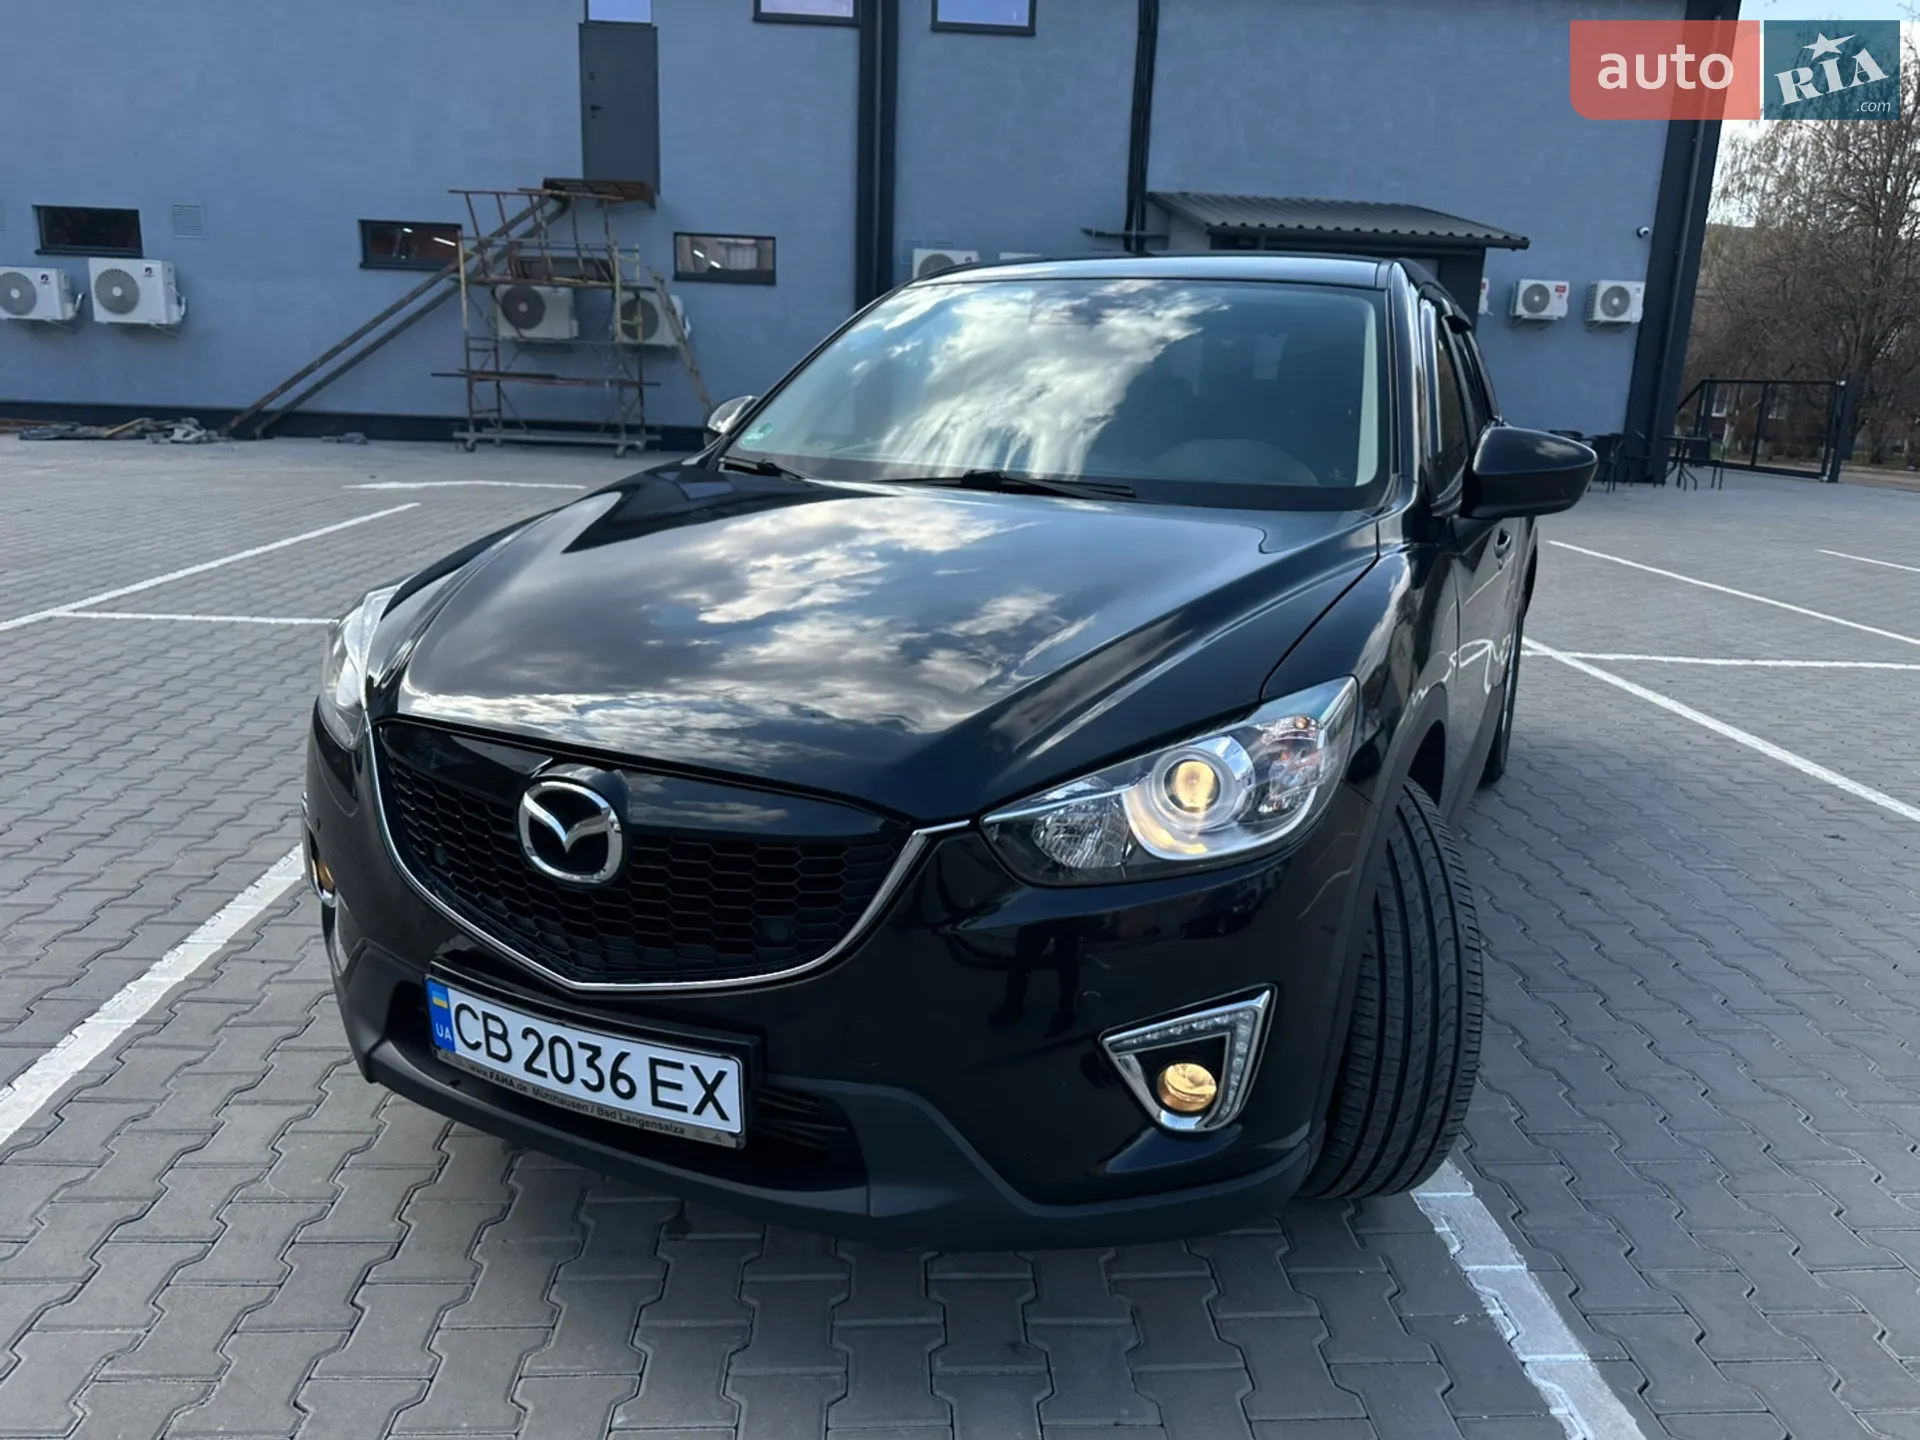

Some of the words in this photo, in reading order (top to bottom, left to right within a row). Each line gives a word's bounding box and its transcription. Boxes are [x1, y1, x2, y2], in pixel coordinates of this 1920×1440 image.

[435, 1024, 453, 1042] UA
[454, 1003, 512, 1063] CB
[521, 1027, 637, 1101] 2036
[649, 1058, 730, 1121] EX
[597, 1106, 616, 1120] Bad
